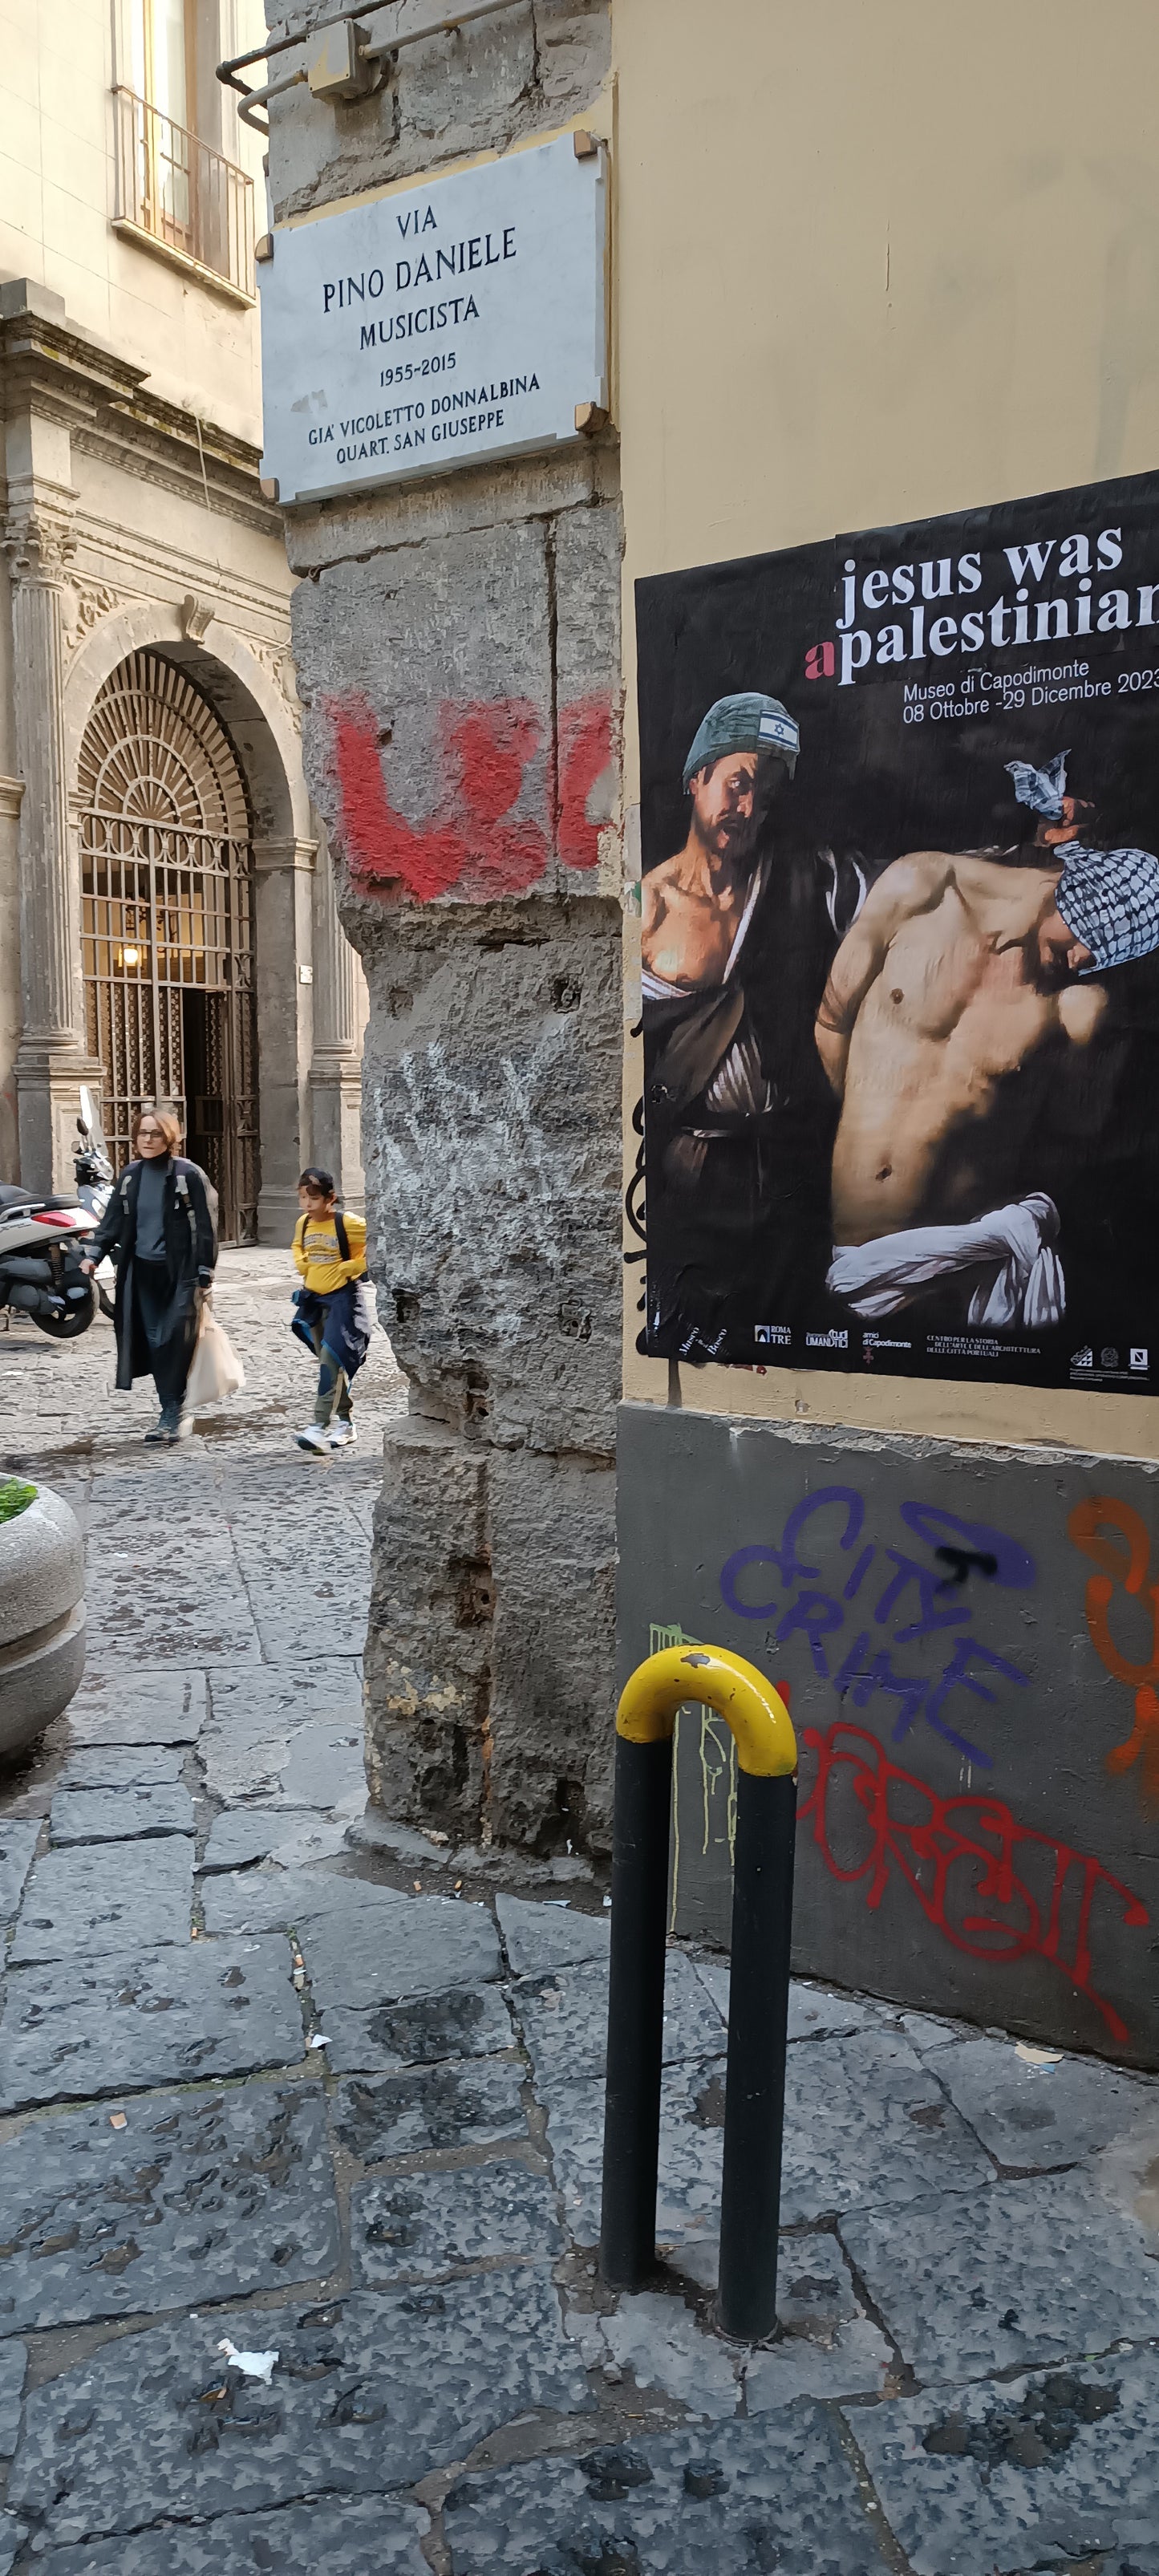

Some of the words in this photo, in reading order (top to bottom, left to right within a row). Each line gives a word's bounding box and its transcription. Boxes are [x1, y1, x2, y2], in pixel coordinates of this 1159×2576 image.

[396, 205, 438, 240] VIA
[322, 269, 384, 314] PINO
[395, 227, 517, 292] DANIELE
[359, 294, 480, 351] MUSICISTA
[379, 352, 457, 387] 1955-2015
[339, 402, 424, 438] VICOLETTO
[431, 373, 541, 416] DONNALBINA
[336, 437, 391, 464] QUART.
[394, 428, 426, 452] SAN
[432, 409, 505, 443] GIUSEPPE
[836, 551, 982, 630] jesus
[1003, 527, 1124, 585] was
[903, 684, 955, 704] Museo
[961, 675, 975, 694] di
[979, 659, 1090, 694] Capodimonte
[903, 704, 924, 724] 08
[930, 696, 989, 720] Ottobre
[1031, 676, 1112, 705] Dicembre
[771, 1325, 792, 1334] ROMA
[771, 1334, 792, 1345] TRE
[869, 1339, 912, 1348] Capodimonte
